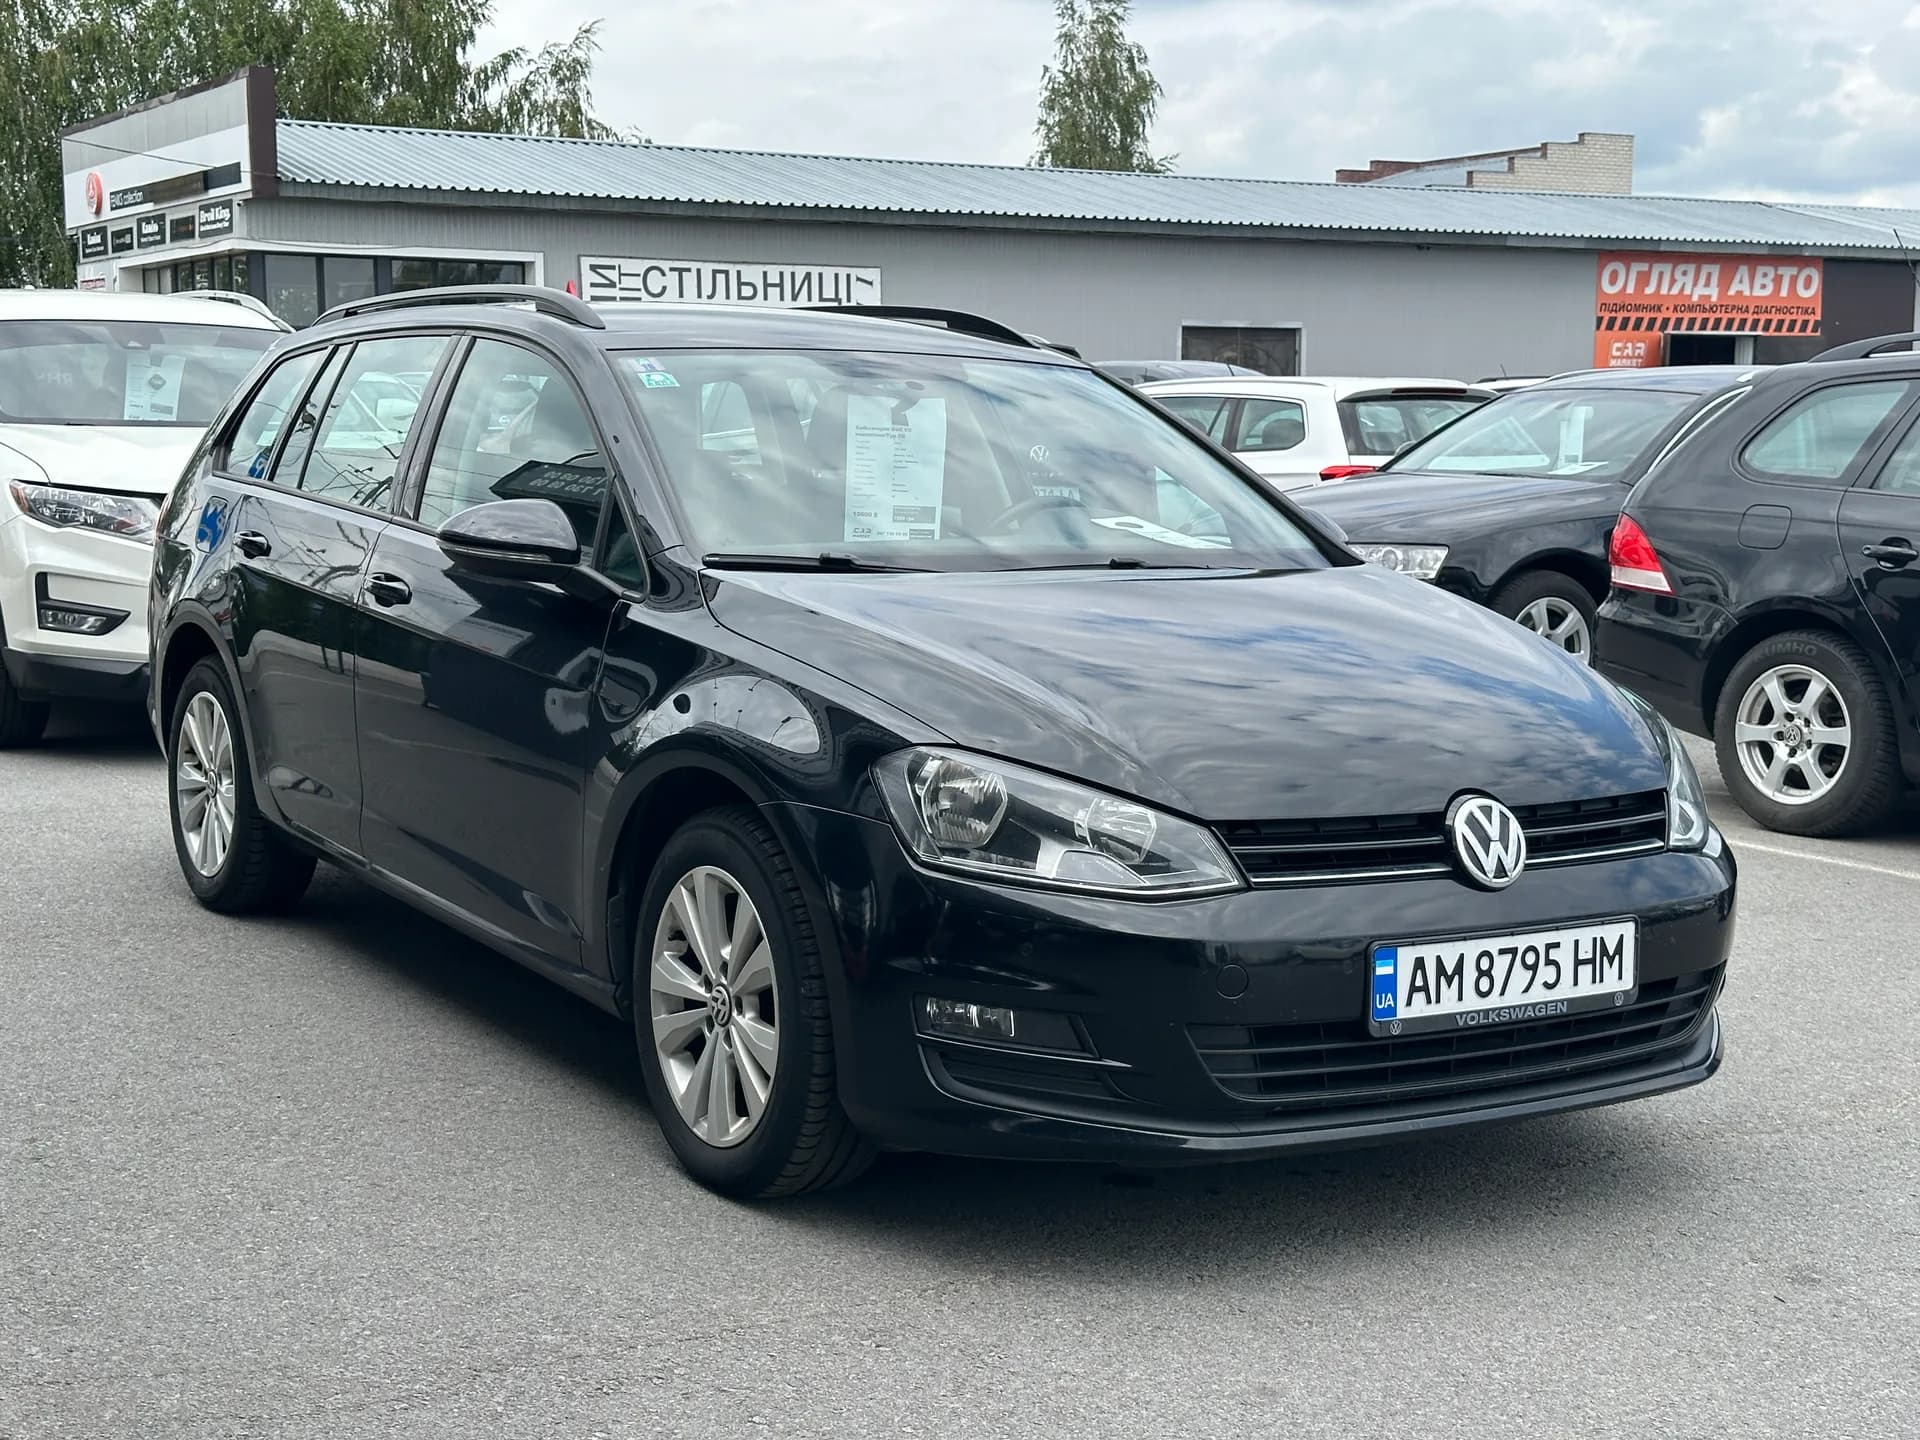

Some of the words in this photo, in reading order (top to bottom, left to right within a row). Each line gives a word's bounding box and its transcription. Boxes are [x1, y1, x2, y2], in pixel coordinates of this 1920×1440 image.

[642, 265, 852, 305] СТІЛЬНИЦІ
[1600, 262, 1721, 302] ОГЛЯД
[1727, 264, 1819, 299] АВТО
[1599, 301, 1663, 314] ПІДЙОМНИК
[1611, 342, 1645, 357] CAR
[1404, 952, 1466, 1008] AM
[1473, 941, 1562, 999] 8795
[1573, 933, 1626, 987] HM
[1375, 993, 1395, 1009] UA
[1455, 1000, 1568, 1026] VOLKSWAGEN
